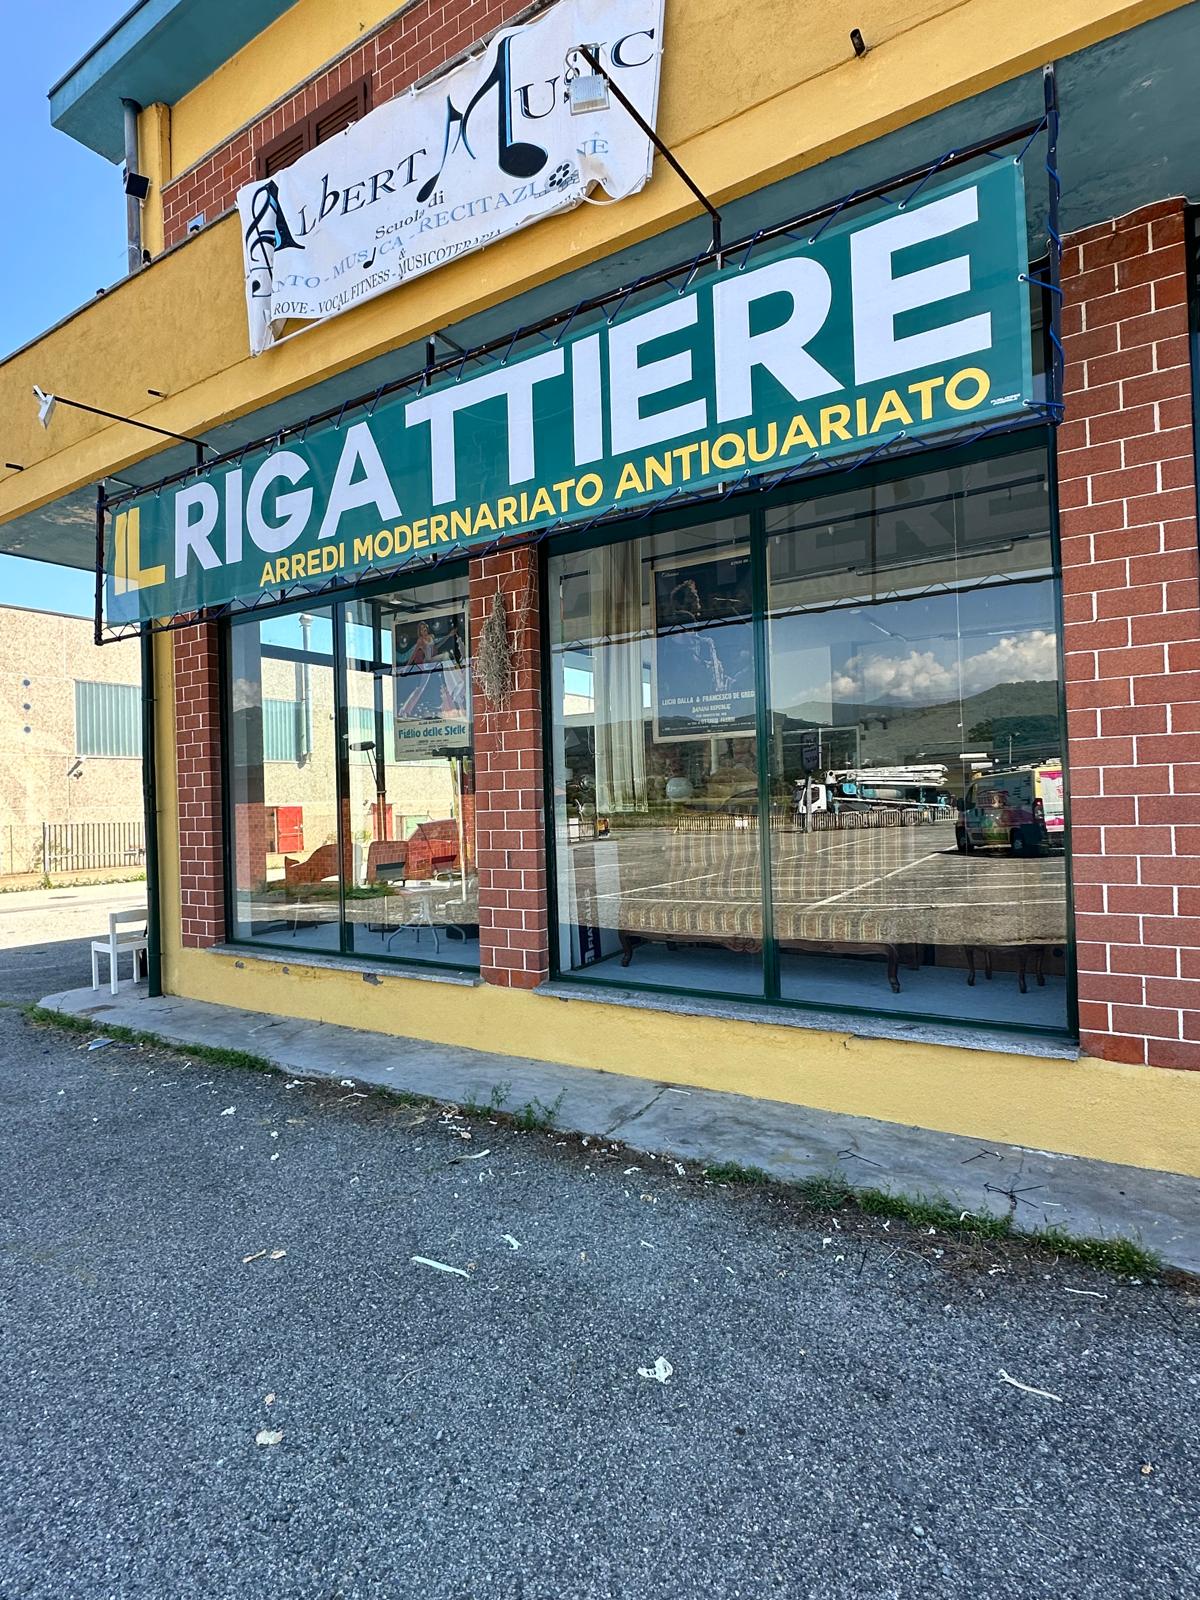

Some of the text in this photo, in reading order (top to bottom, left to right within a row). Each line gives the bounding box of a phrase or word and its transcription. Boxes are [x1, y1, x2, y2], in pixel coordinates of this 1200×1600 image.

[428, 190, 445, 209] di
[318, 292, 351, 314] VOCAL
[350, 268, 391, 300] FITNESS
[260, 368, 991, 588] ARREDI MODERNARIATO ANTIQUARIATO
[114, 507, 167, 596] IL
[398, 727, 421, 740] Figlio
[422, 726, 443, 738] delle
